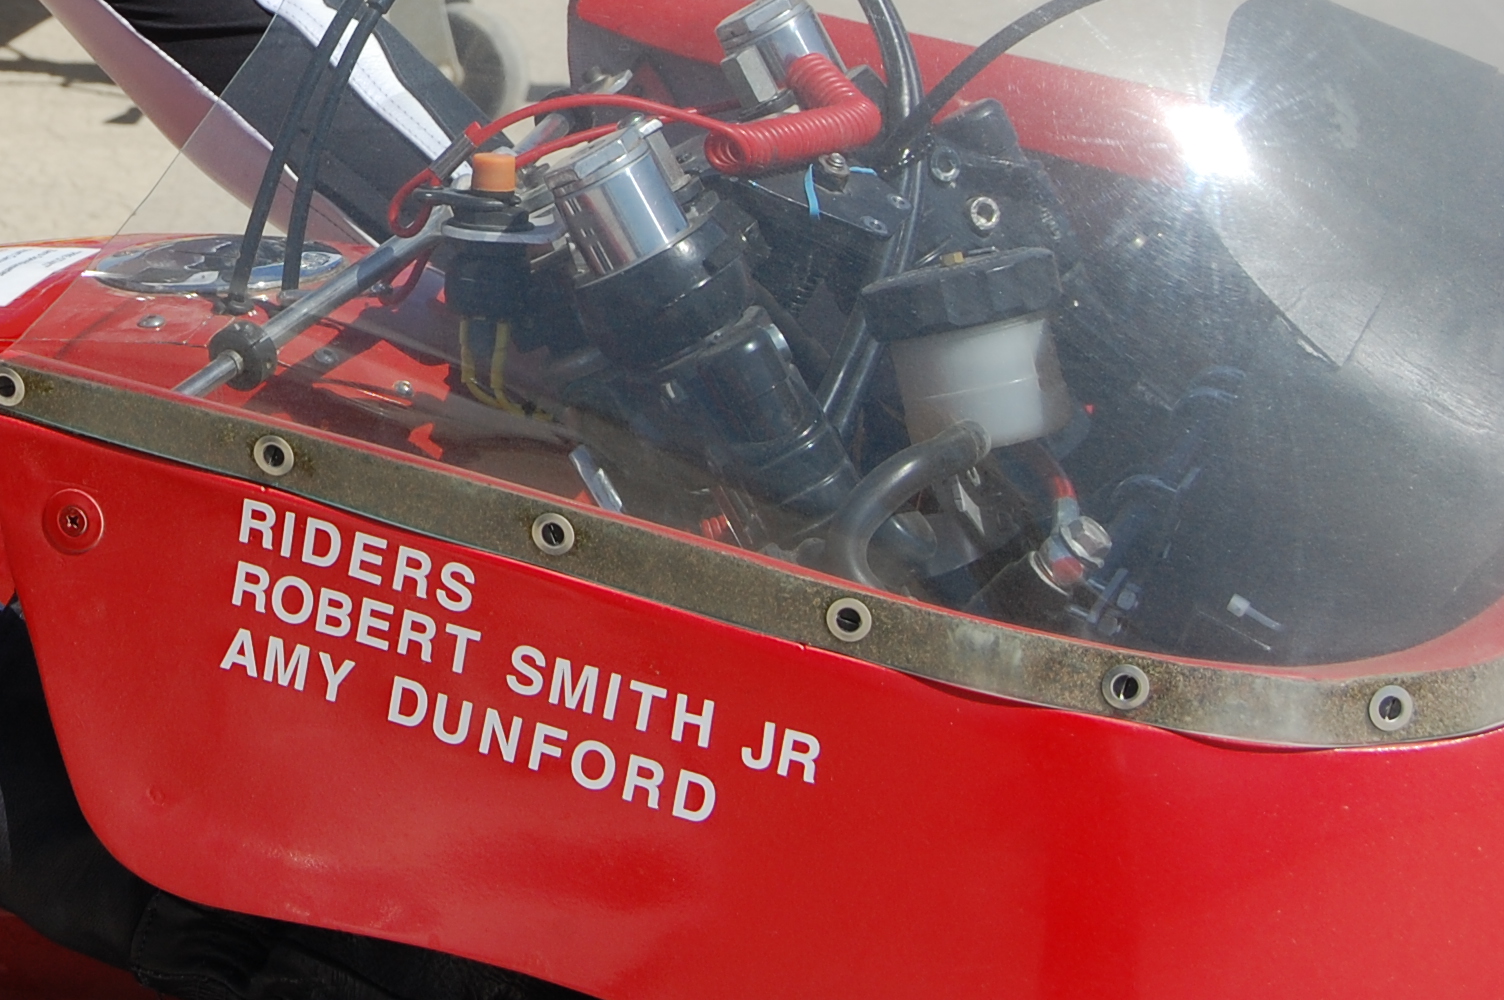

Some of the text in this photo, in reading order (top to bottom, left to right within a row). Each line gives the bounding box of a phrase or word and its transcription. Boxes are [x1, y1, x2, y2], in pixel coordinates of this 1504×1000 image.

[238, 498, 475, 612] RIDERS
[219, 628, 716, 822] AMY DUNFORD
[231, 560, 821, 784] ROBERT SMITH JR
